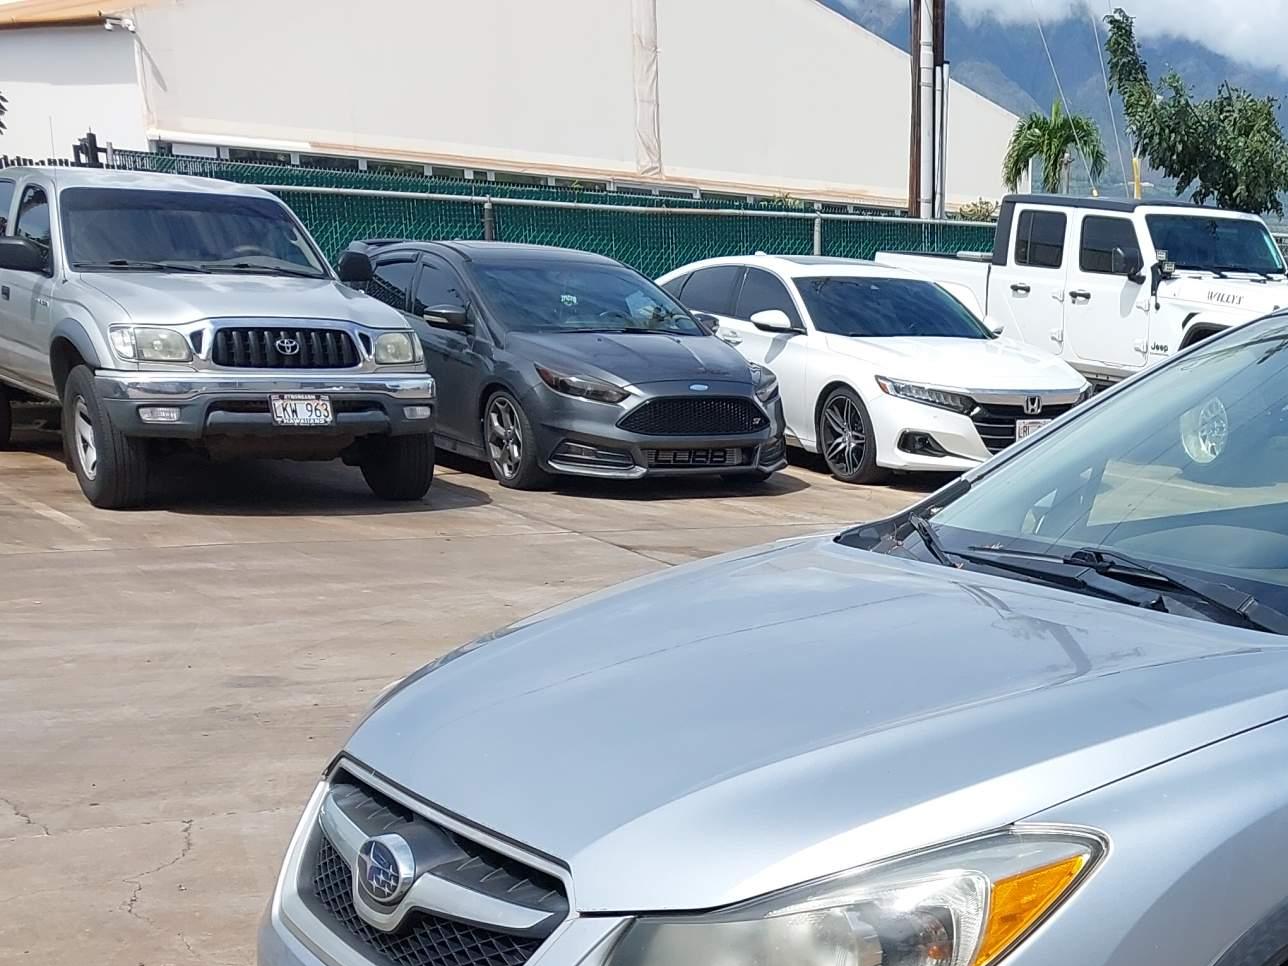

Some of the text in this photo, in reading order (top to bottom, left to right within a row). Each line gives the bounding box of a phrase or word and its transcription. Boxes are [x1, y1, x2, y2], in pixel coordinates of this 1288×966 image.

[1150, 341, 1169, 352] Jeep
[272, 402, 330, 418] LKW 963
